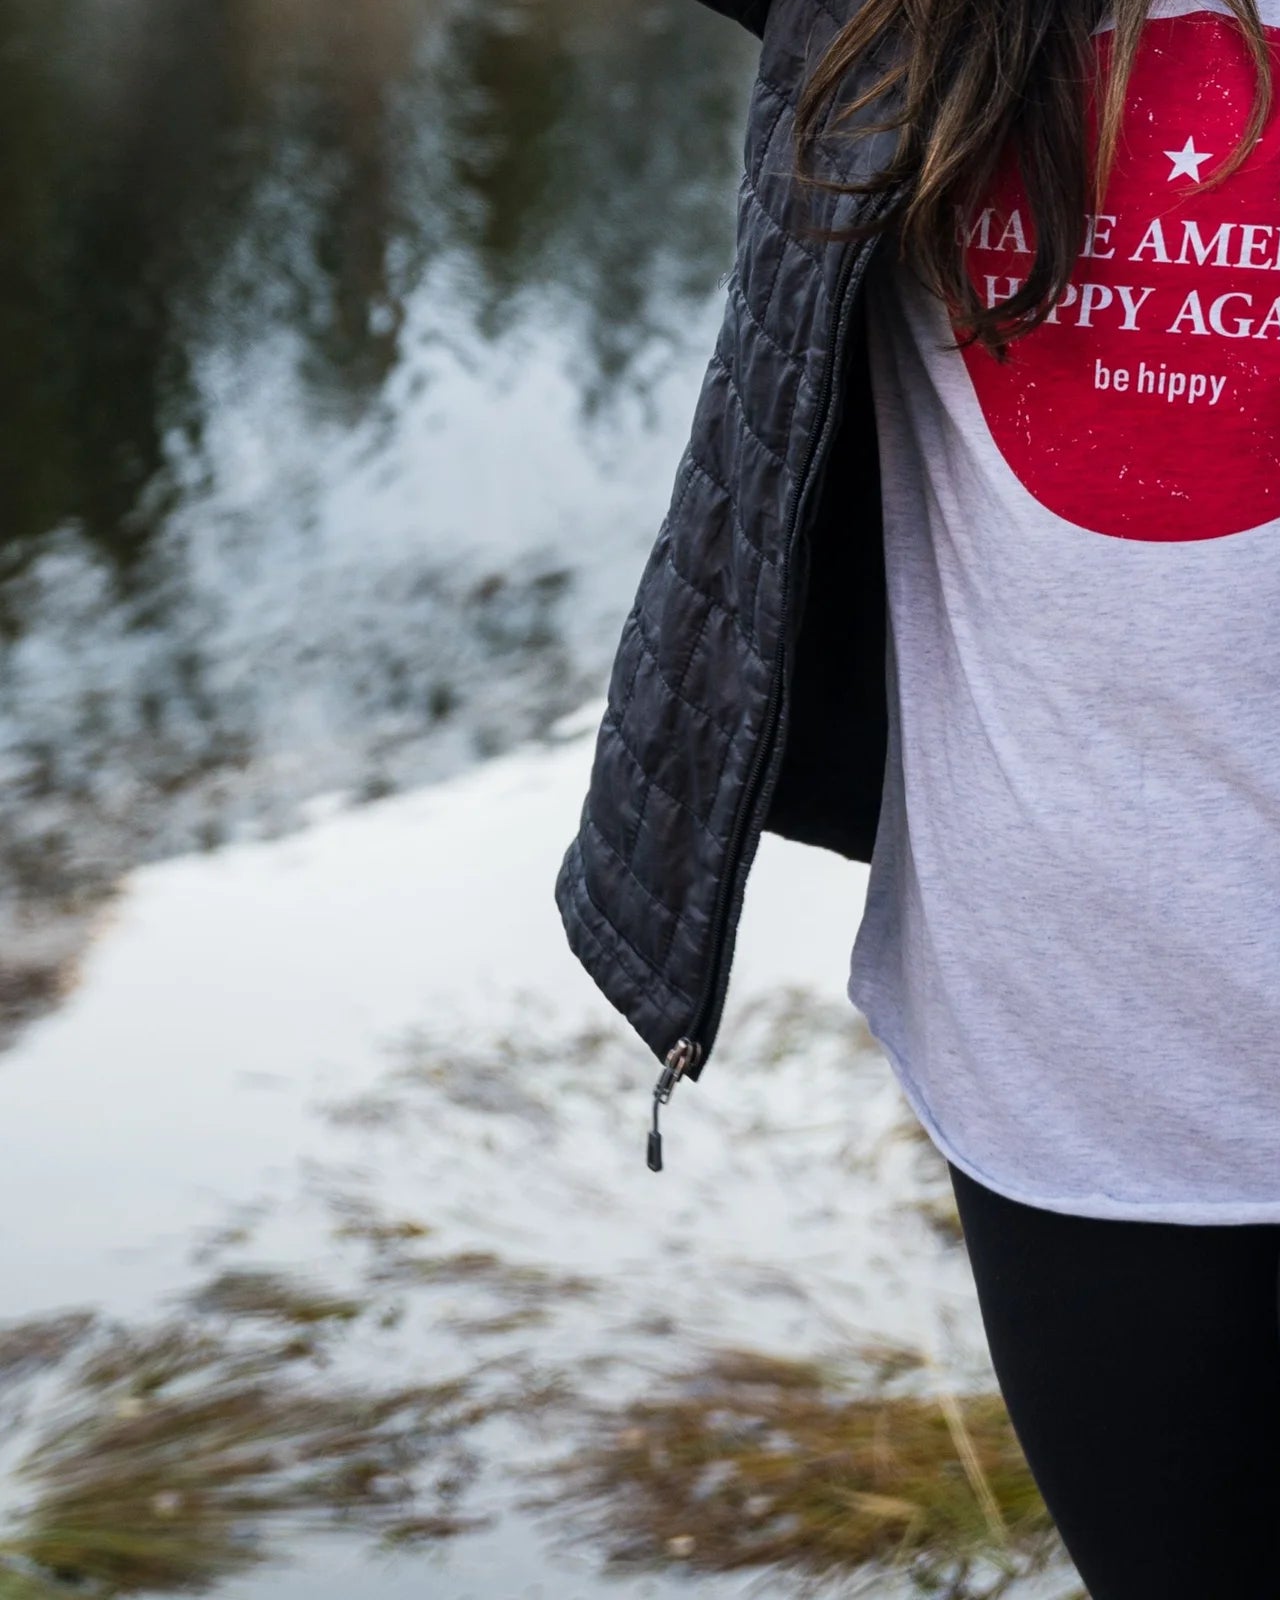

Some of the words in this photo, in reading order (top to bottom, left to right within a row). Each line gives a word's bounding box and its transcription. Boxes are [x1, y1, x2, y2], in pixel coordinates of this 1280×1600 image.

[953, 204, 1117, 260] MAE
[983, 274, 1156, 332] HPPY
[1094, 358, 1130, 392] be
[1137, 361, 1227, 406] hippy
